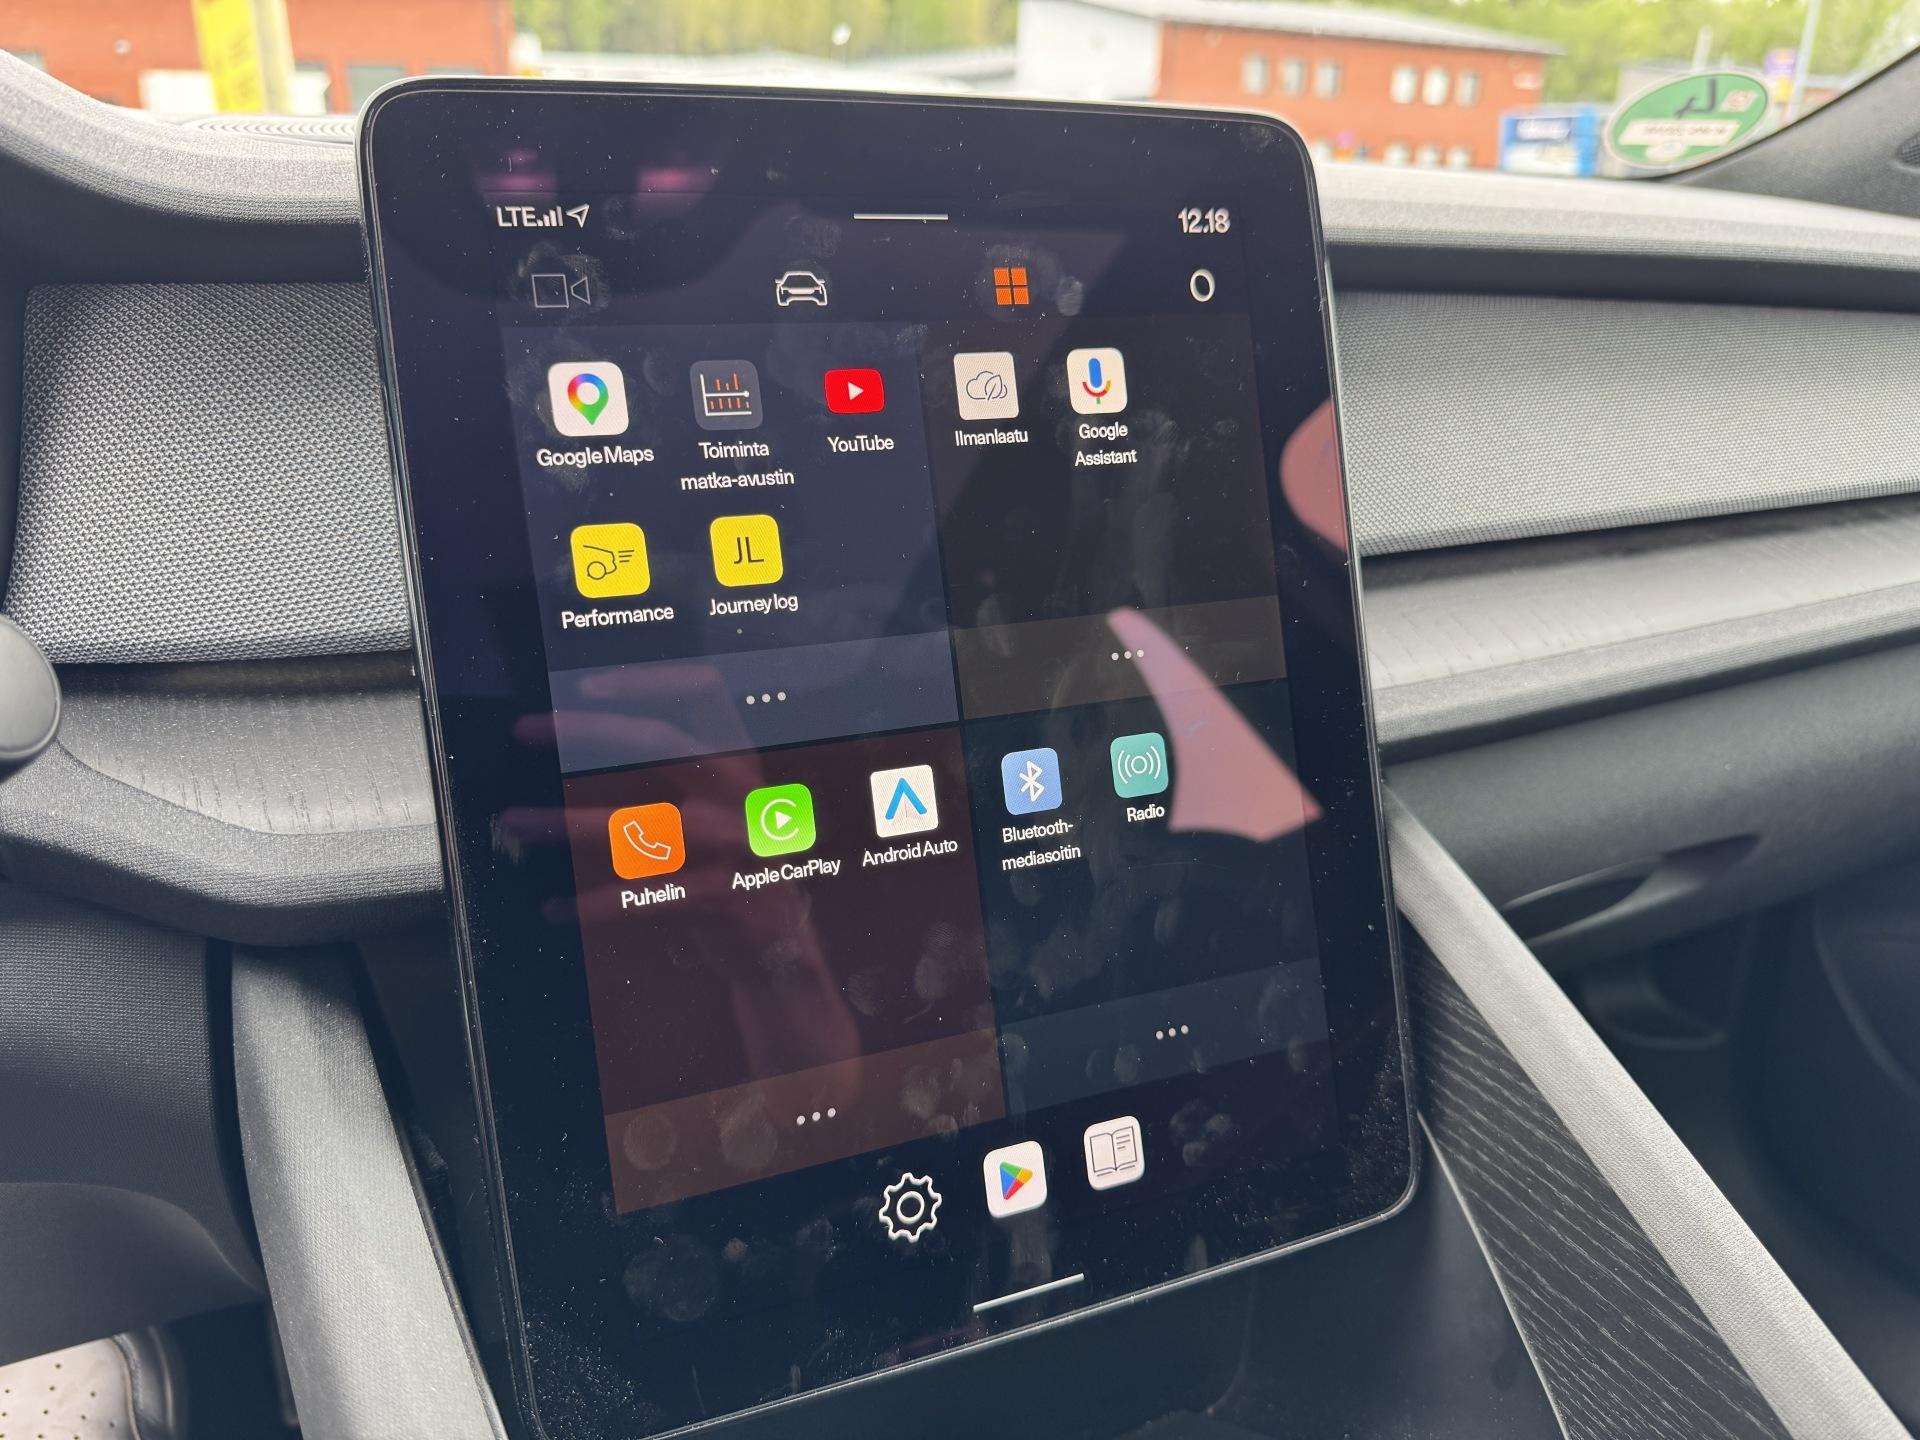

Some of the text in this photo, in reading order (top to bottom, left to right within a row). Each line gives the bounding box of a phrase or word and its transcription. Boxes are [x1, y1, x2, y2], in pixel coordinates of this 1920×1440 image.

[496, 206, 535, 227] LTE
[1177, 207, 1231, 235] 12.18
[954, 428, 1029, 447] Ilmanlaatu
[1078, 421, 1129, 441] Google
[697, 440, 770, 460] Toiminta
[826, 434, 895, 453] YouTube
[535, 445, 655, 469] Google Maps
[1074, 449, 1138, 467] Assistant
[680, 468, 795, 491] matka-avustin
[733, 536, 765, 566] JL
[709, 593, 799, 617] Journey log
[561, 606, 675, 630] Performance
[1126, 803, 1166, 823] Radio
[1002, 818, 1074, 843] Bluetooth-
[862, 837, 959, 868] Android Auto
[1001, 844, 1082, 871] mediasoitin
[731, 856, 841, 891] Apple CarPlay
[620, 882, 686, 909] Puhelin
